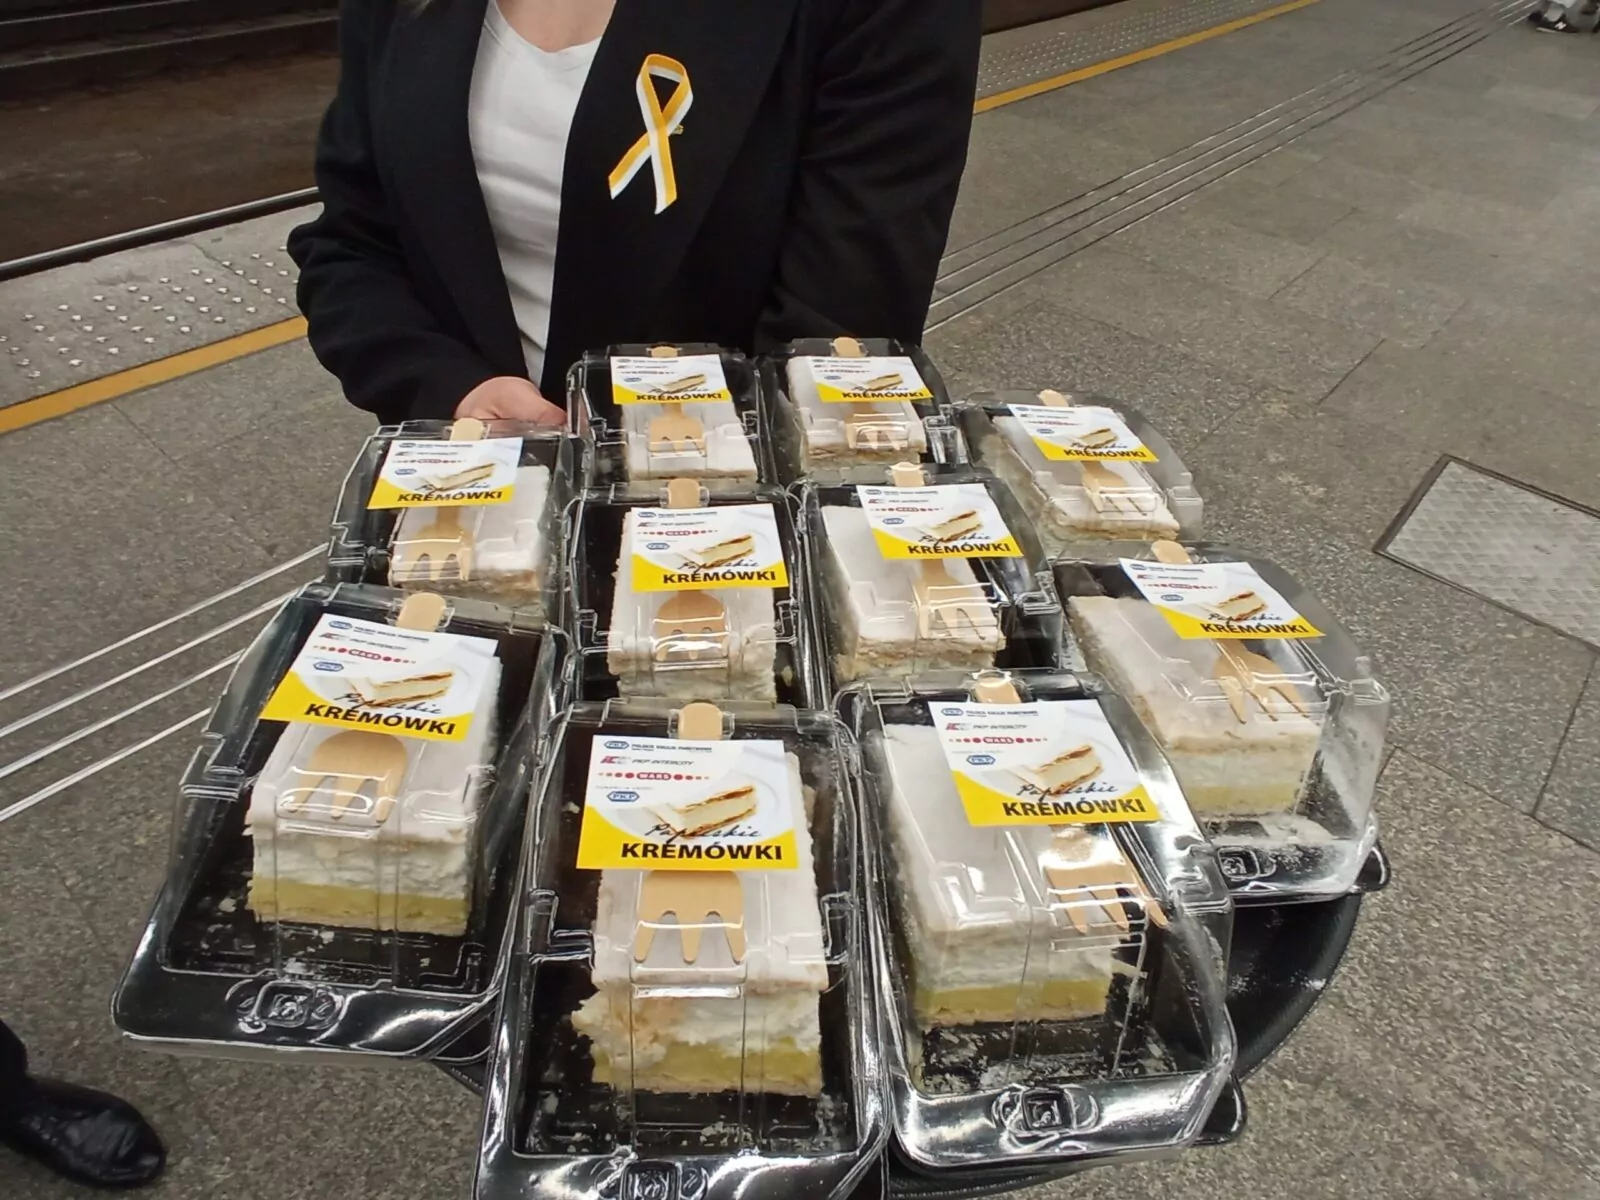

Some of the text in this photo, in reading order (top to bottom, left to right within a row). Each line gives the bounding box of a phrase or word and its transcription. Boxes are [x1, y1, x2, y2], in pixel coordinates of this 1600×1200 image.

[397, 491, 503, 502] KREMÓWKI
[907, 542, 1011, 554] KREMÓWKI
[663, 569, 776, 584] KREMÓWKI
[1199, 622, 1309, 634] KREMÓWKI
[304, 703, 456, 735] KREMÓWKI
[610, 792, 637, 800] PKP
[1002, 797, 1146, 816] KREMÓWKI
[621, 841, 783, 860] KREMÓWKI
